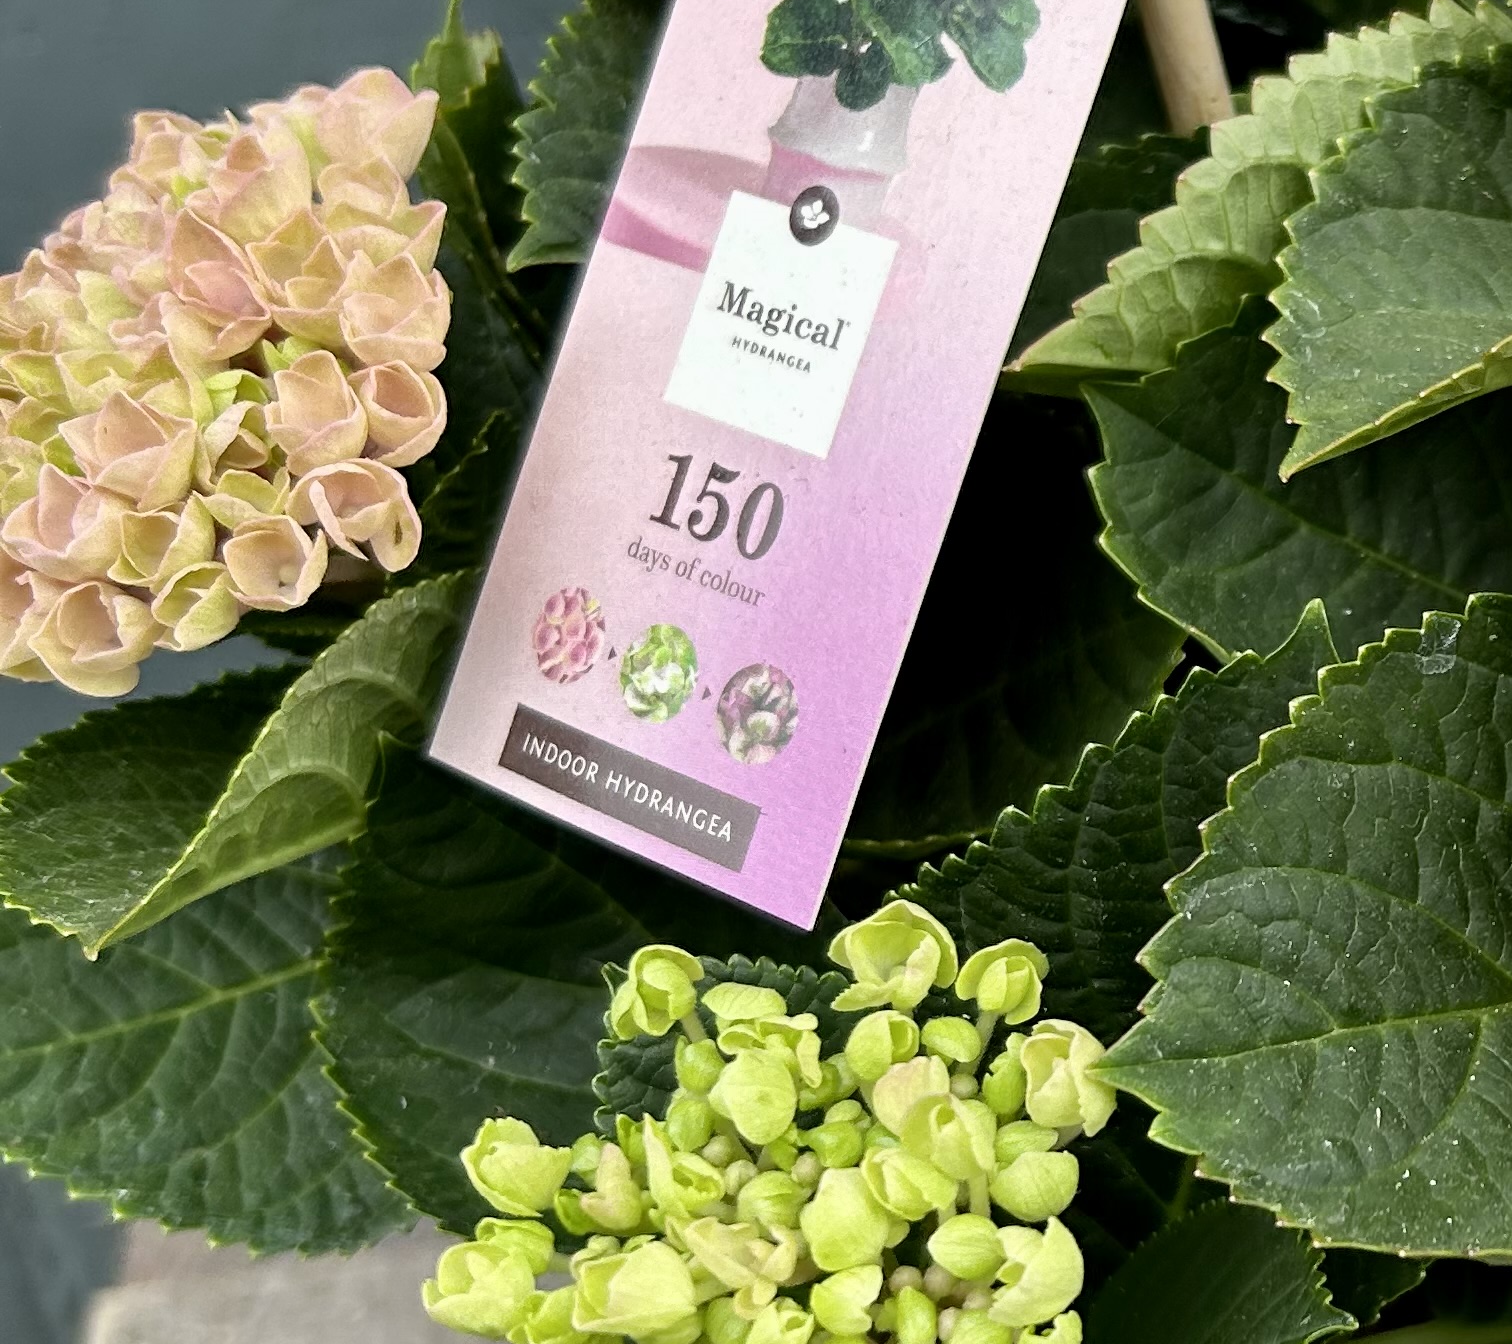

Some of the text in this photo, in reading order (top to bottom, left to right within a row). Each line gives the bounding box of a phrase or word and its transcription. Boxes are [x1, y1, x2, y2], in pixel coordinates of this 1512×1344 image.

[731, 335, 811, 373] HYDRANGEA
[649, 454, 784, 560] 150
[627, 535, 765, 607] days of colour
[522, 732, 732, 842] INDOOR HYDRANGEA
